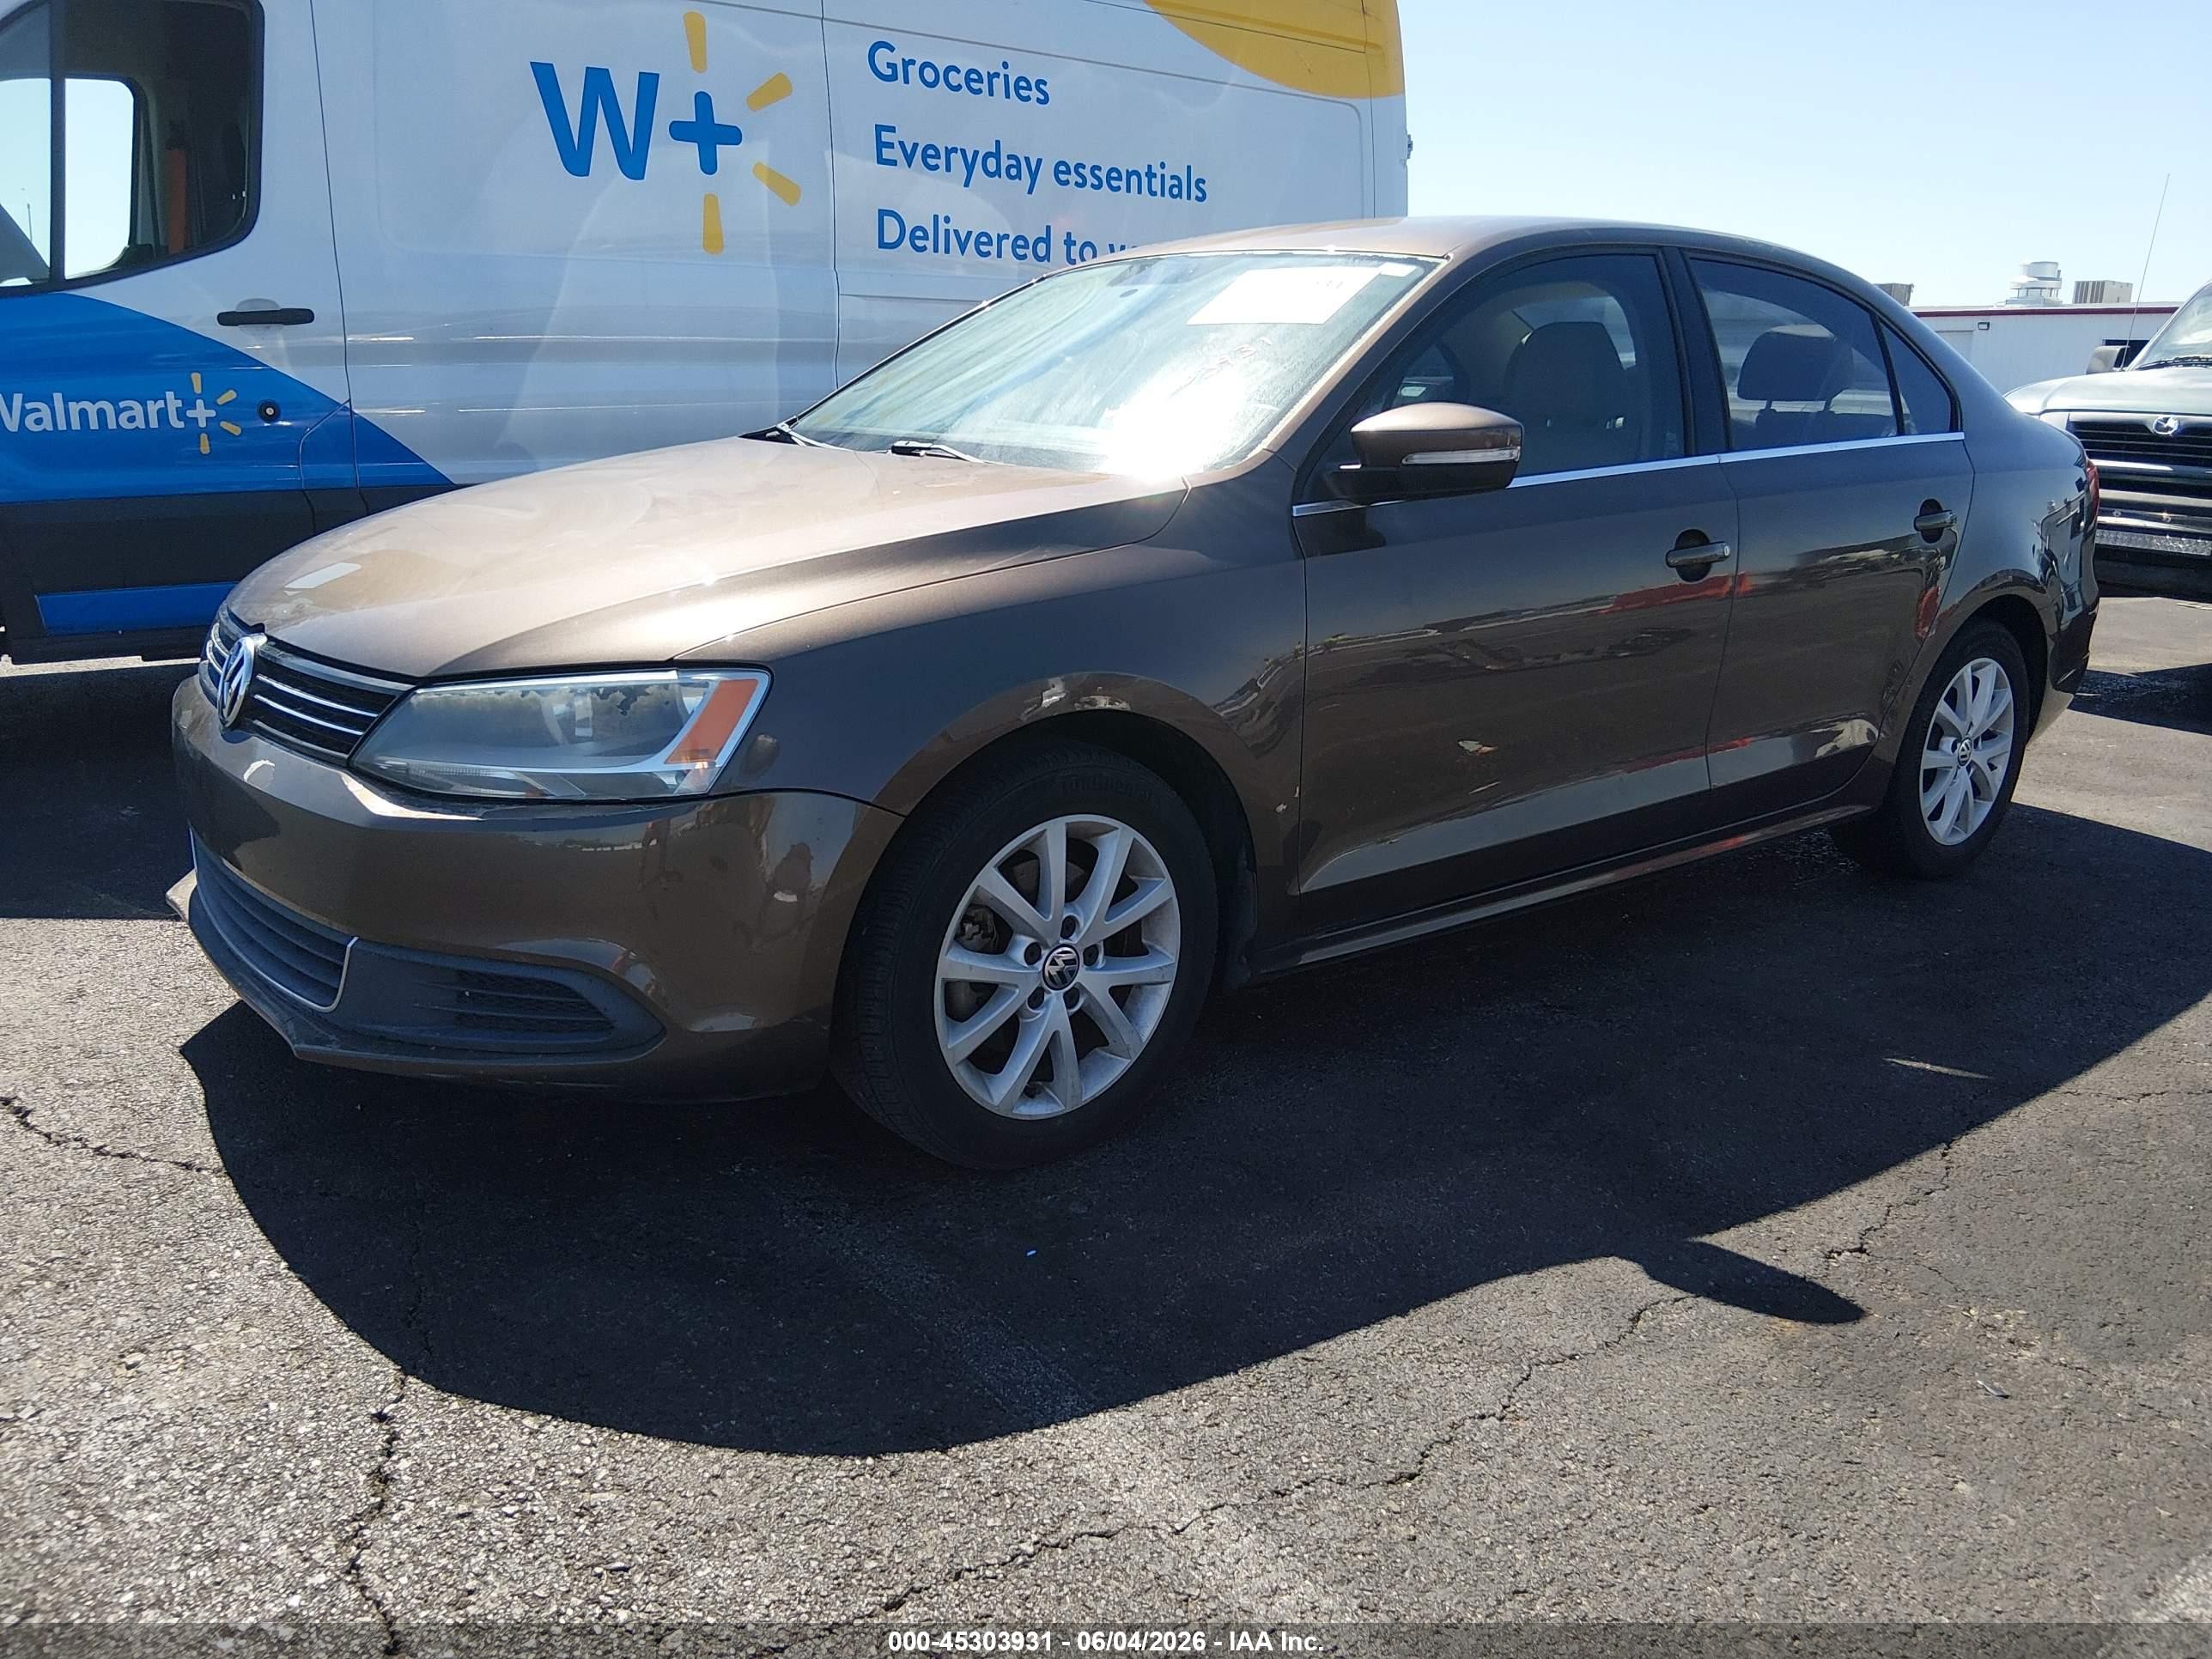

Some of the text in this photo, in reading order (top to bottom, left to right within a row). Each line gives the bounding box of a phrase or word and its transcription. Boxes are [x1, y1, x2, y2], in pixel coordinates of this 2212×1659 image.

[867, 40, 1050, 106] Groceries
[874, 123, 1207, 203] Everyday essentials
[878, 208, 1097, 265] Delivered to
